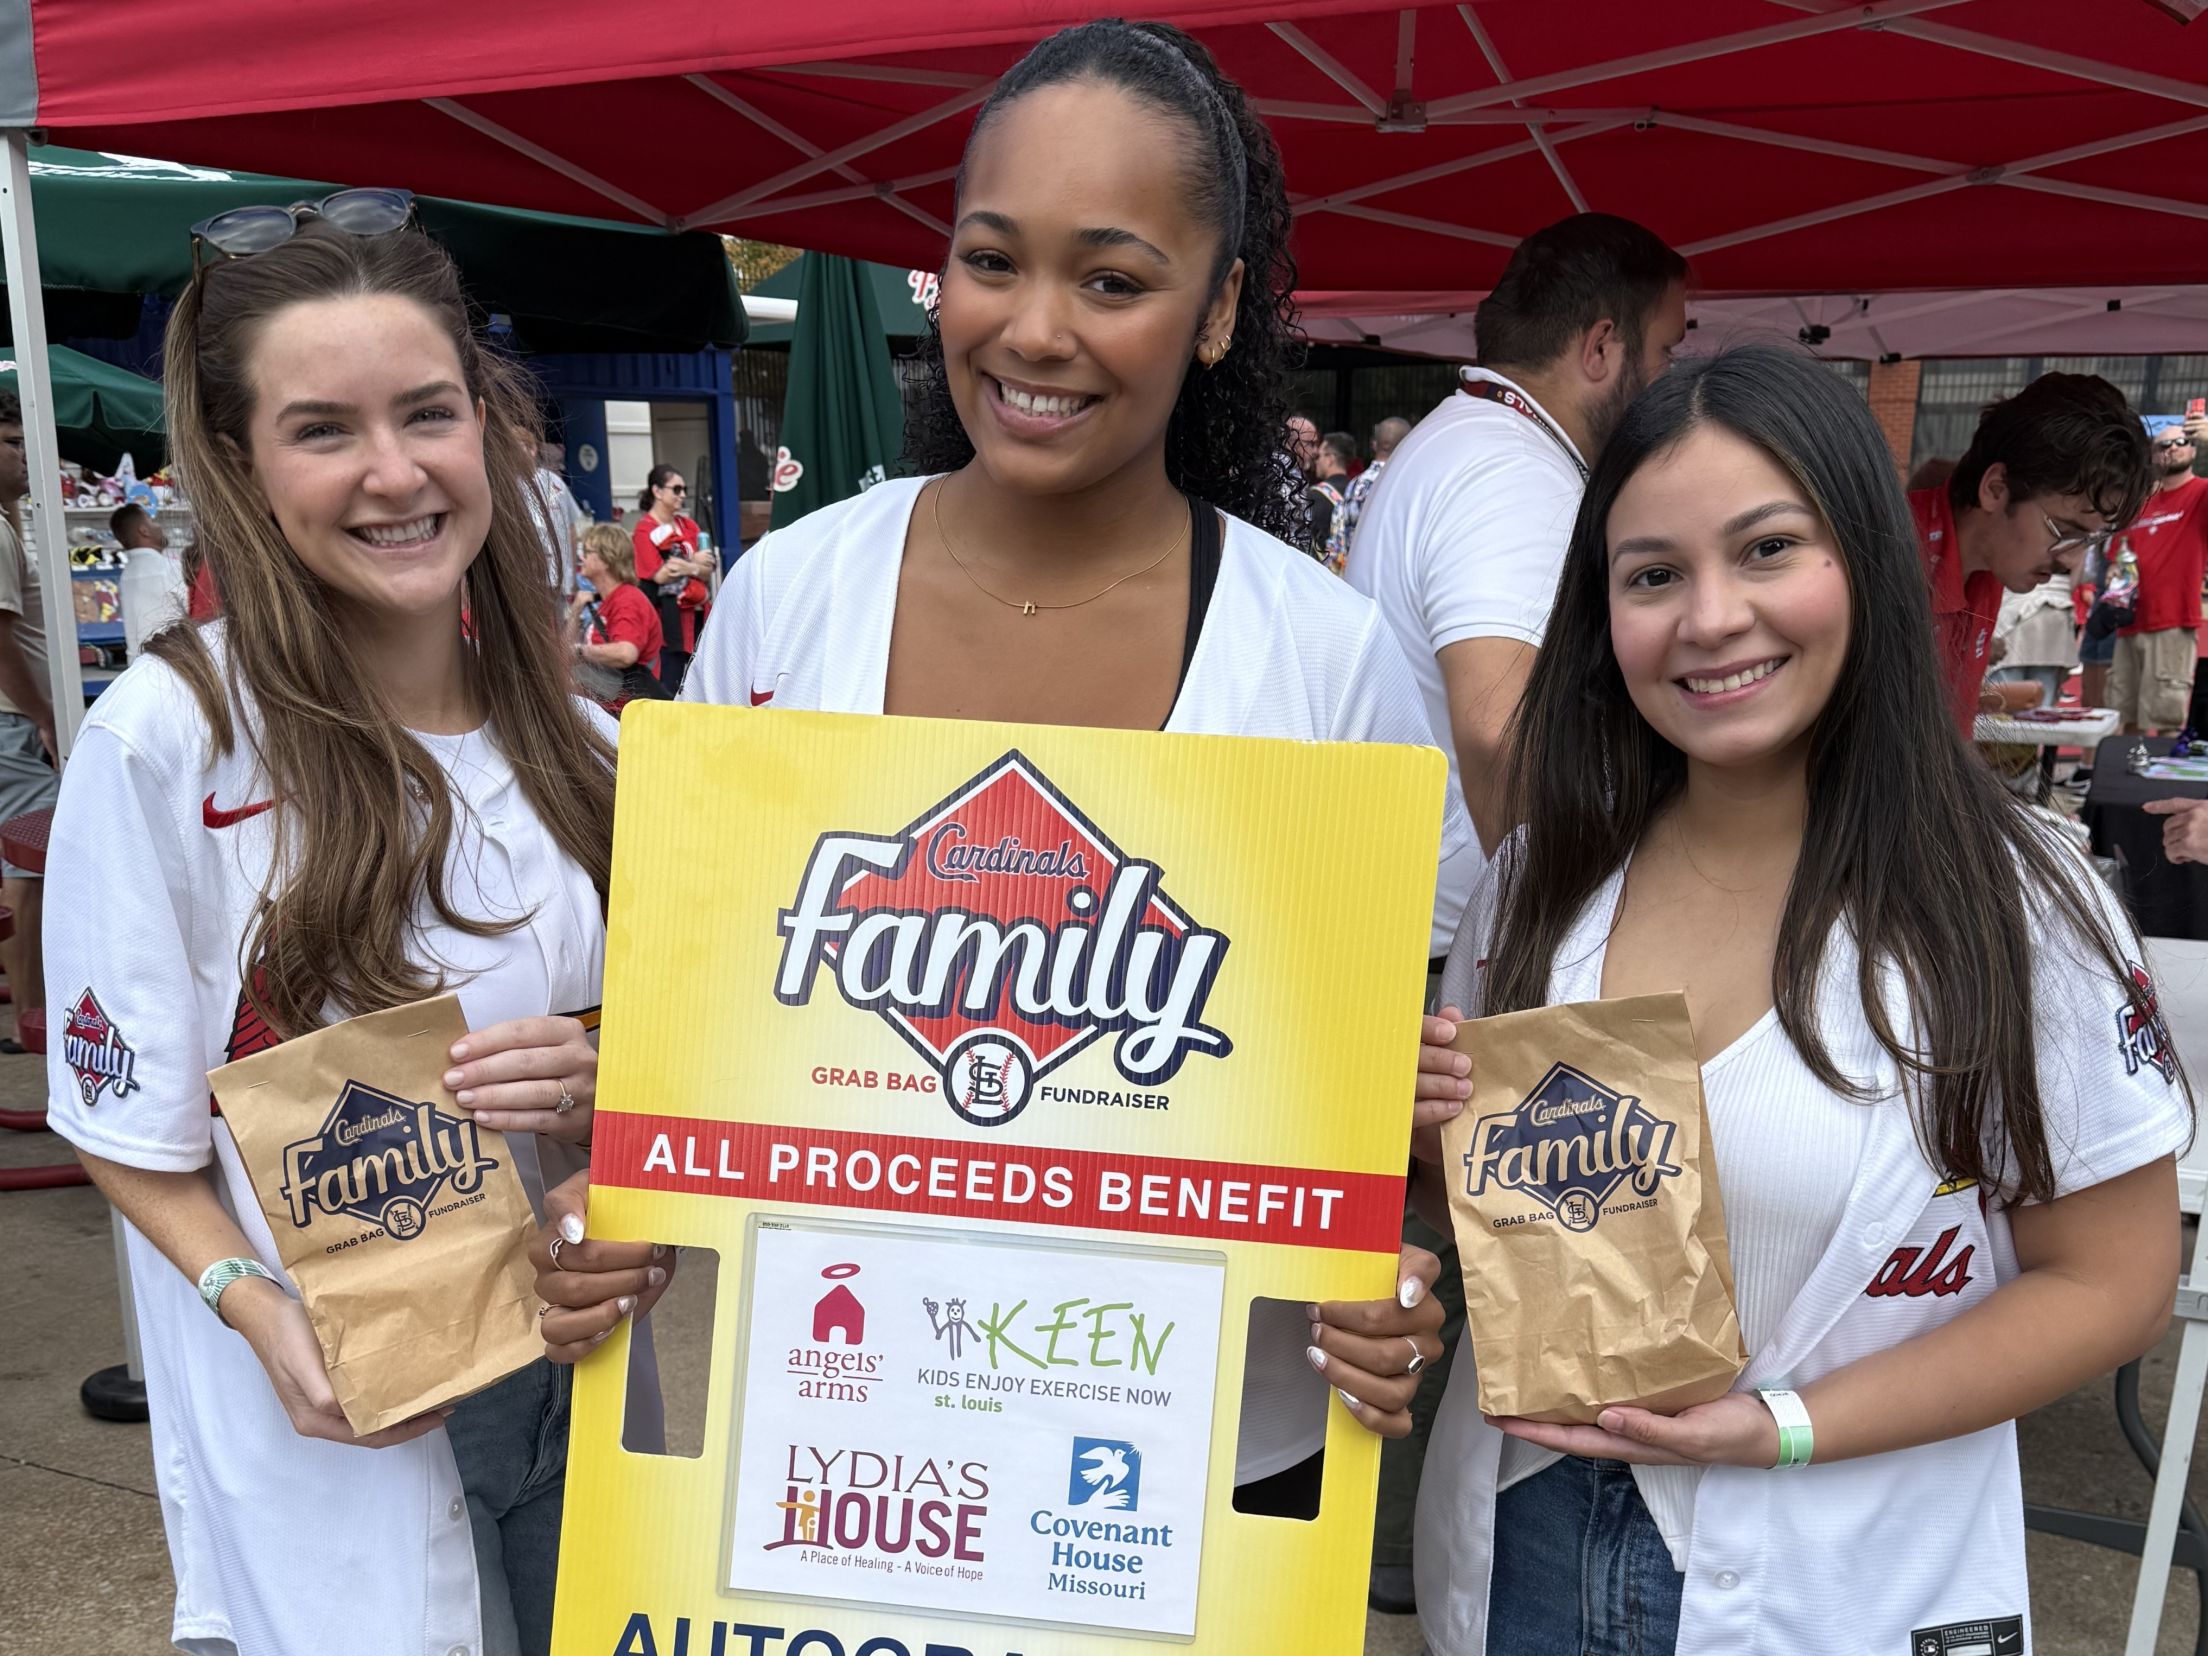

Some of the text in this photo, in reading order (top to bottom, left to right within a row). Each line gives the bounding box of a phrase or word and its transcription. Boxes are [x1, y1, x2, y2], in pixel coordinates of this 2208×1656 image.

[926, 822, 1088, 883] Cardinals
[777, 836, 1224, 1078] Family
[811, 1066, 1170, 1112] GRAB BAG FUNDRAISER
[335, 1106, 406, 1147] Cardinals
[1529, 1097, 1607, 1127] Cardinals
[282, 1103, 494, 1225] Family
[1465, 1097, 1679, 1193] Family
[643, 1133, 1345, 1230] ALL PROCEEDS BENEFIT
[326, 1192, 487, 1254] GRAB BAG FUNDRAISER
[1493, 1198, 1659, 1229] GRAB BAG FUNDRAISER
[977, 1298, 1175, 1376] KEEN
[788, 1348, 884, 1379] angels'
[798, 1380, 869, 1403] arms
[917, 1368, 1172, 1407] KIDS ENJOY EXERCISE NOW
[934, 1394, 1003, 1413] st. louis
[786, 1444, 990, 1500] LYDIA'S
[780, 1486, 989, 1562] HOUSE
[1030, 1510, 1174, 1548] Covenant
[800, 1550, 808, 1562] A
[810, 1551, 839, 1566] Place
[841, 1554, 852, 1567] of
[855, 1555, 894, 1574] Healing
[904, 1560, 912, 1573] A
[915, 1562, 943, 1577] Voice
[943, 1564, 954, 1578] of
[957, 1566, 984, 1582] Hope
[1051, 1541, 1144, 1574] House
[1048, 1572, 1146, 1600] Missouri
